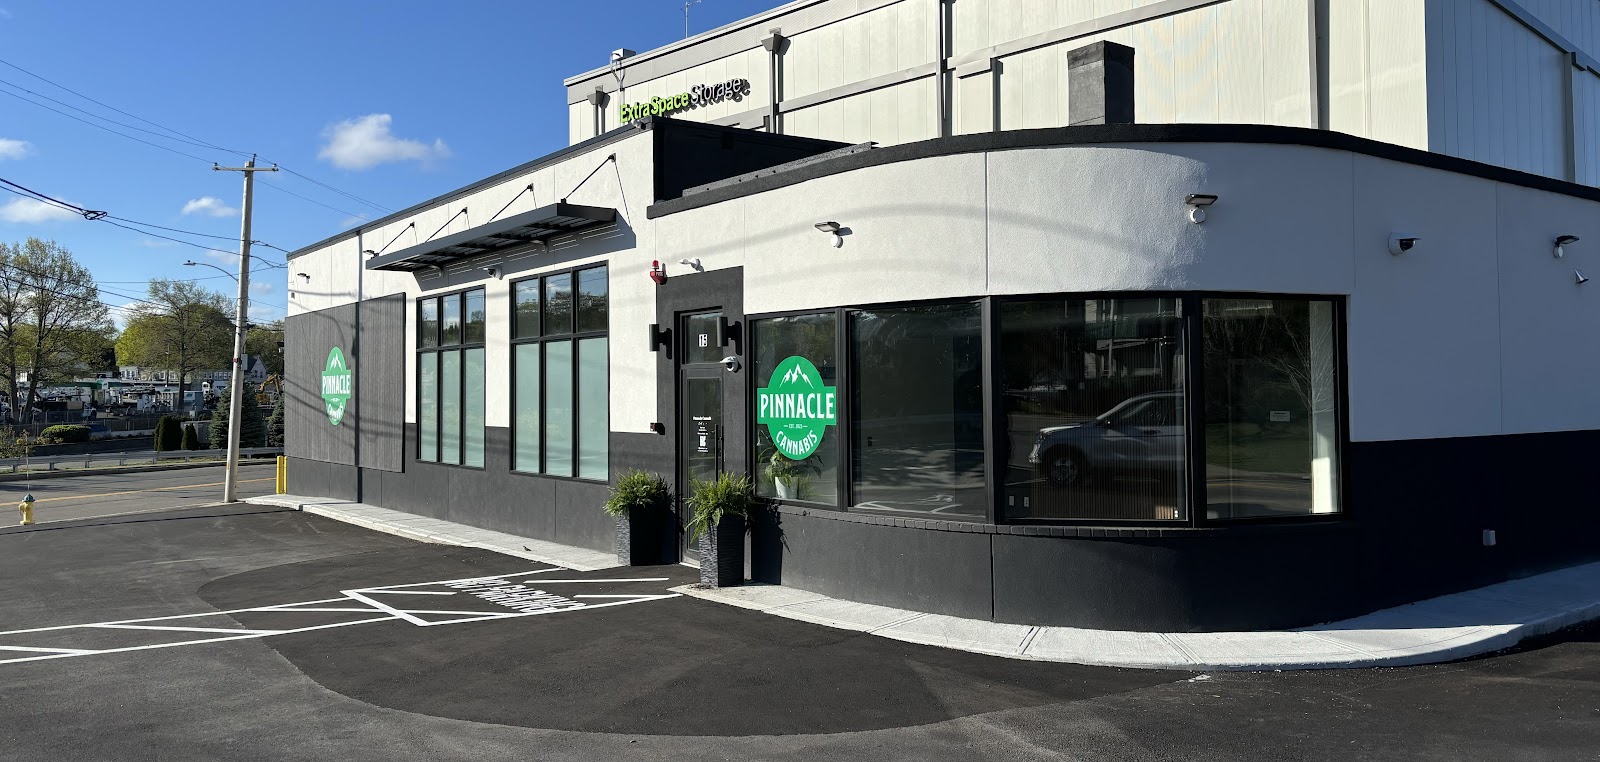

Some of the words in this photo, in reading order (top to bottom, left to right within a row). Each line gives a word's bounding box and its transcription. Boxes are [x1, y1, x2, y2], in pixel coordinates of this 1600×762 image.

[690, 78, 741, 104] Storage
[322, 374, 351, 395] PINNACLE
[760, 392, 835, 419] PINNACLE
[776, 429, 818, 455] CANNABIS
